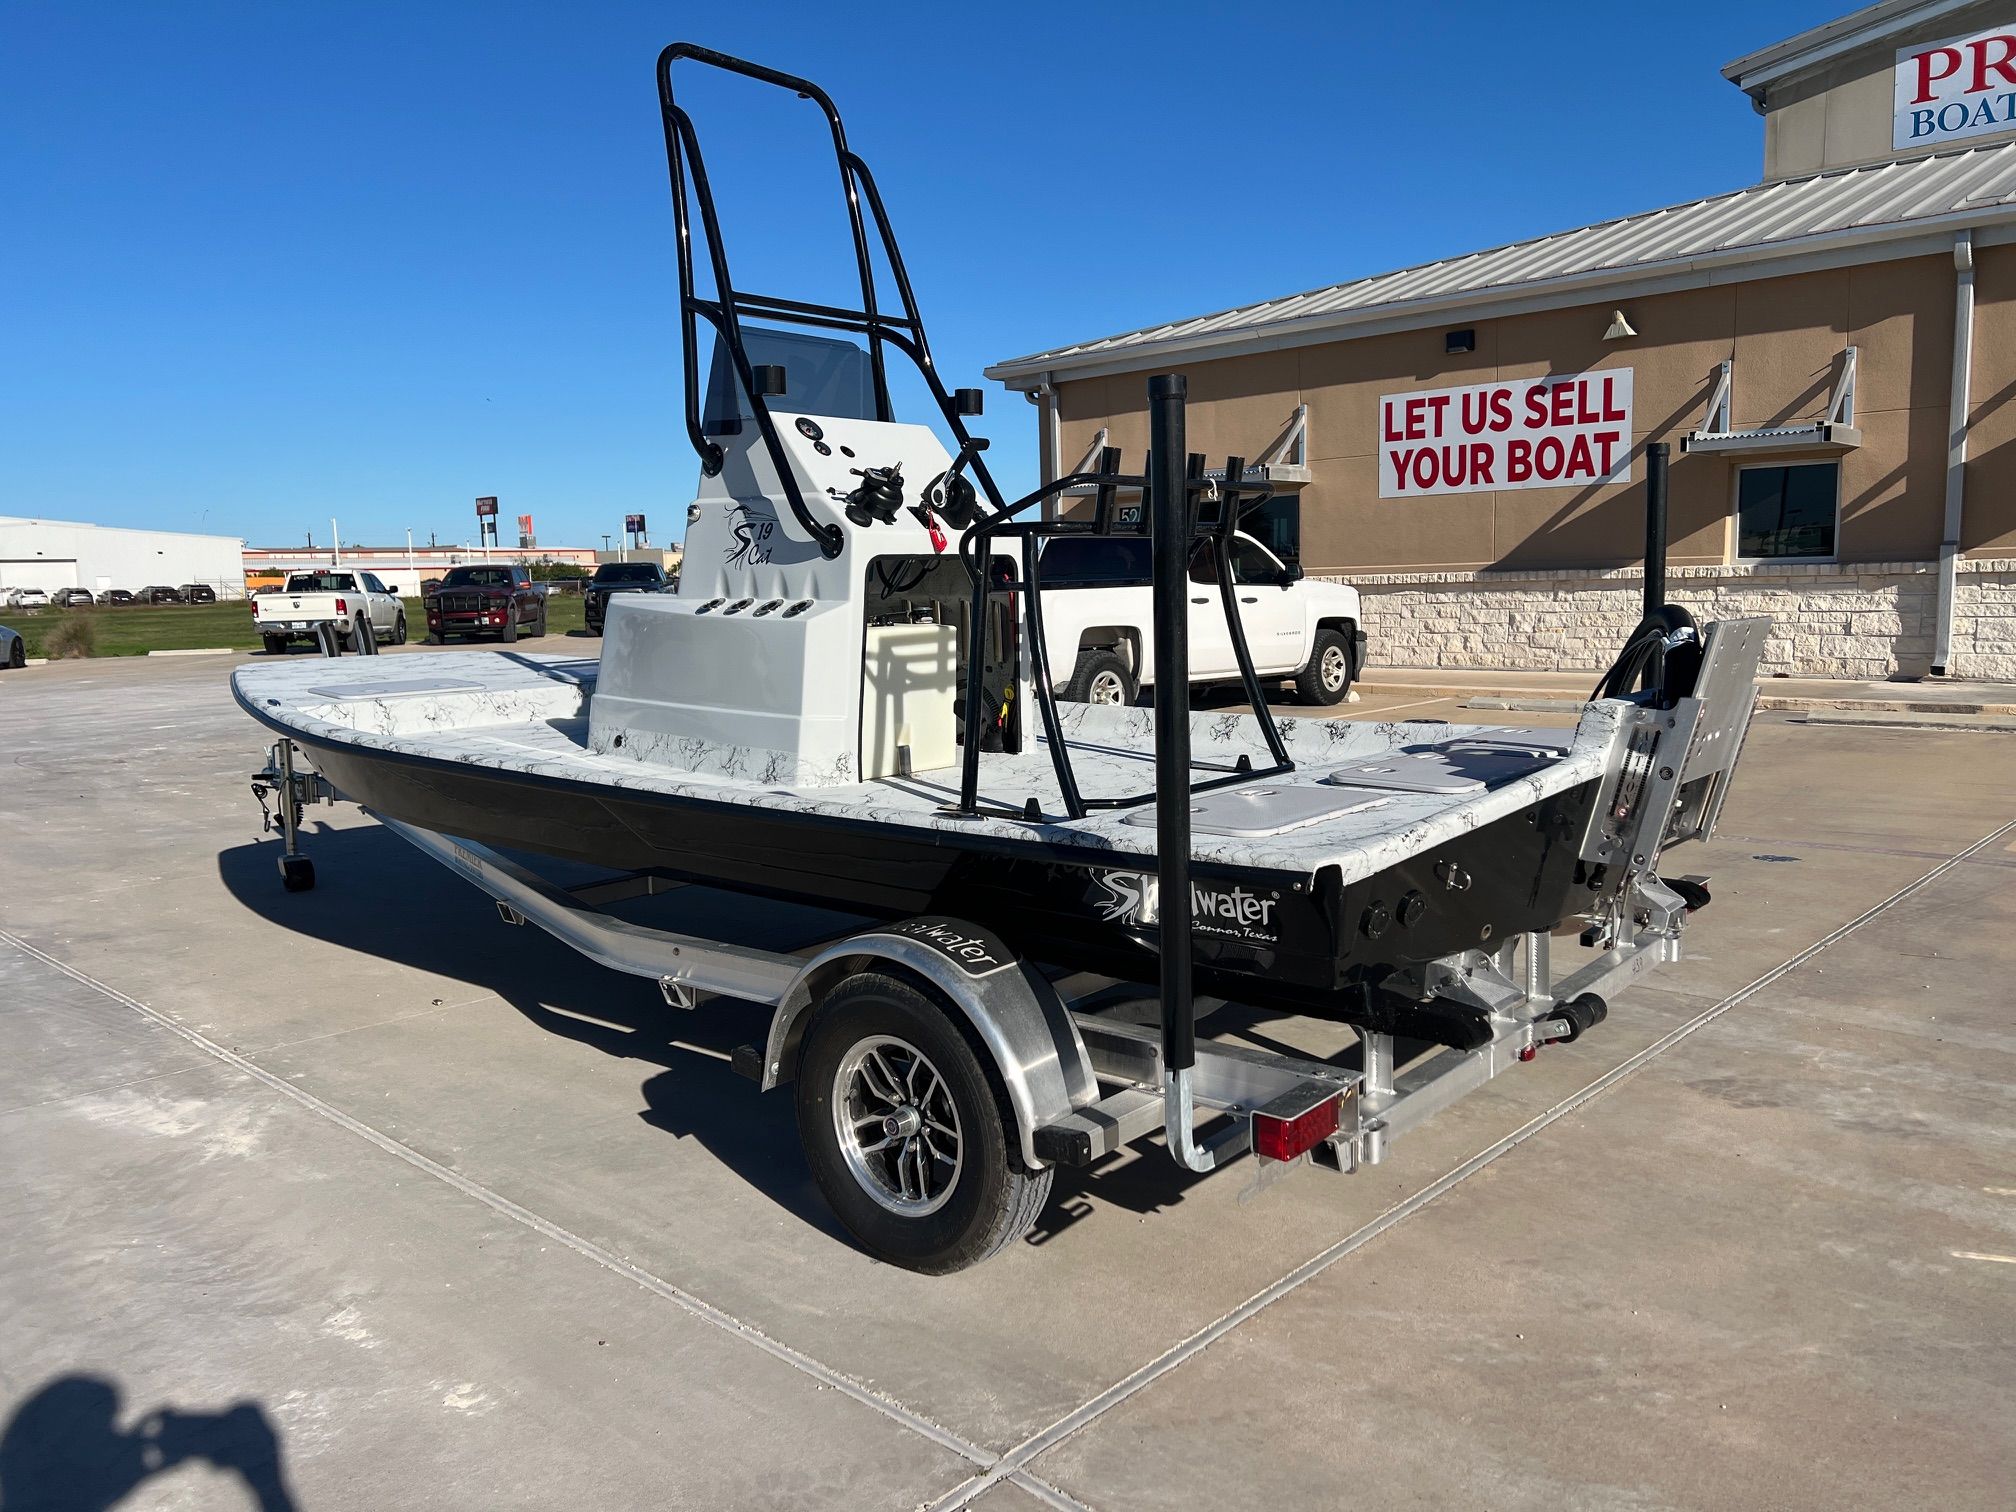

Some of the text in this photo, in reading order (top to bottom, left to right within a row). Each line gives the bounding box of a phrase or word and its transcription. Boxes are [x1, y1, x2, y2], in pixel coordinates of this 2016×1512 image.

[1385, 377, 1626, 442] LET US SELL
[1389, 431, 1620, 490] YOUR BOAT
[758, 522, 774, 540] 19
[748, 544, 773, 565] Cat
[1101, 870, 1276, 926] Shlwater
[1242, 927, 1278, 942] Texas
